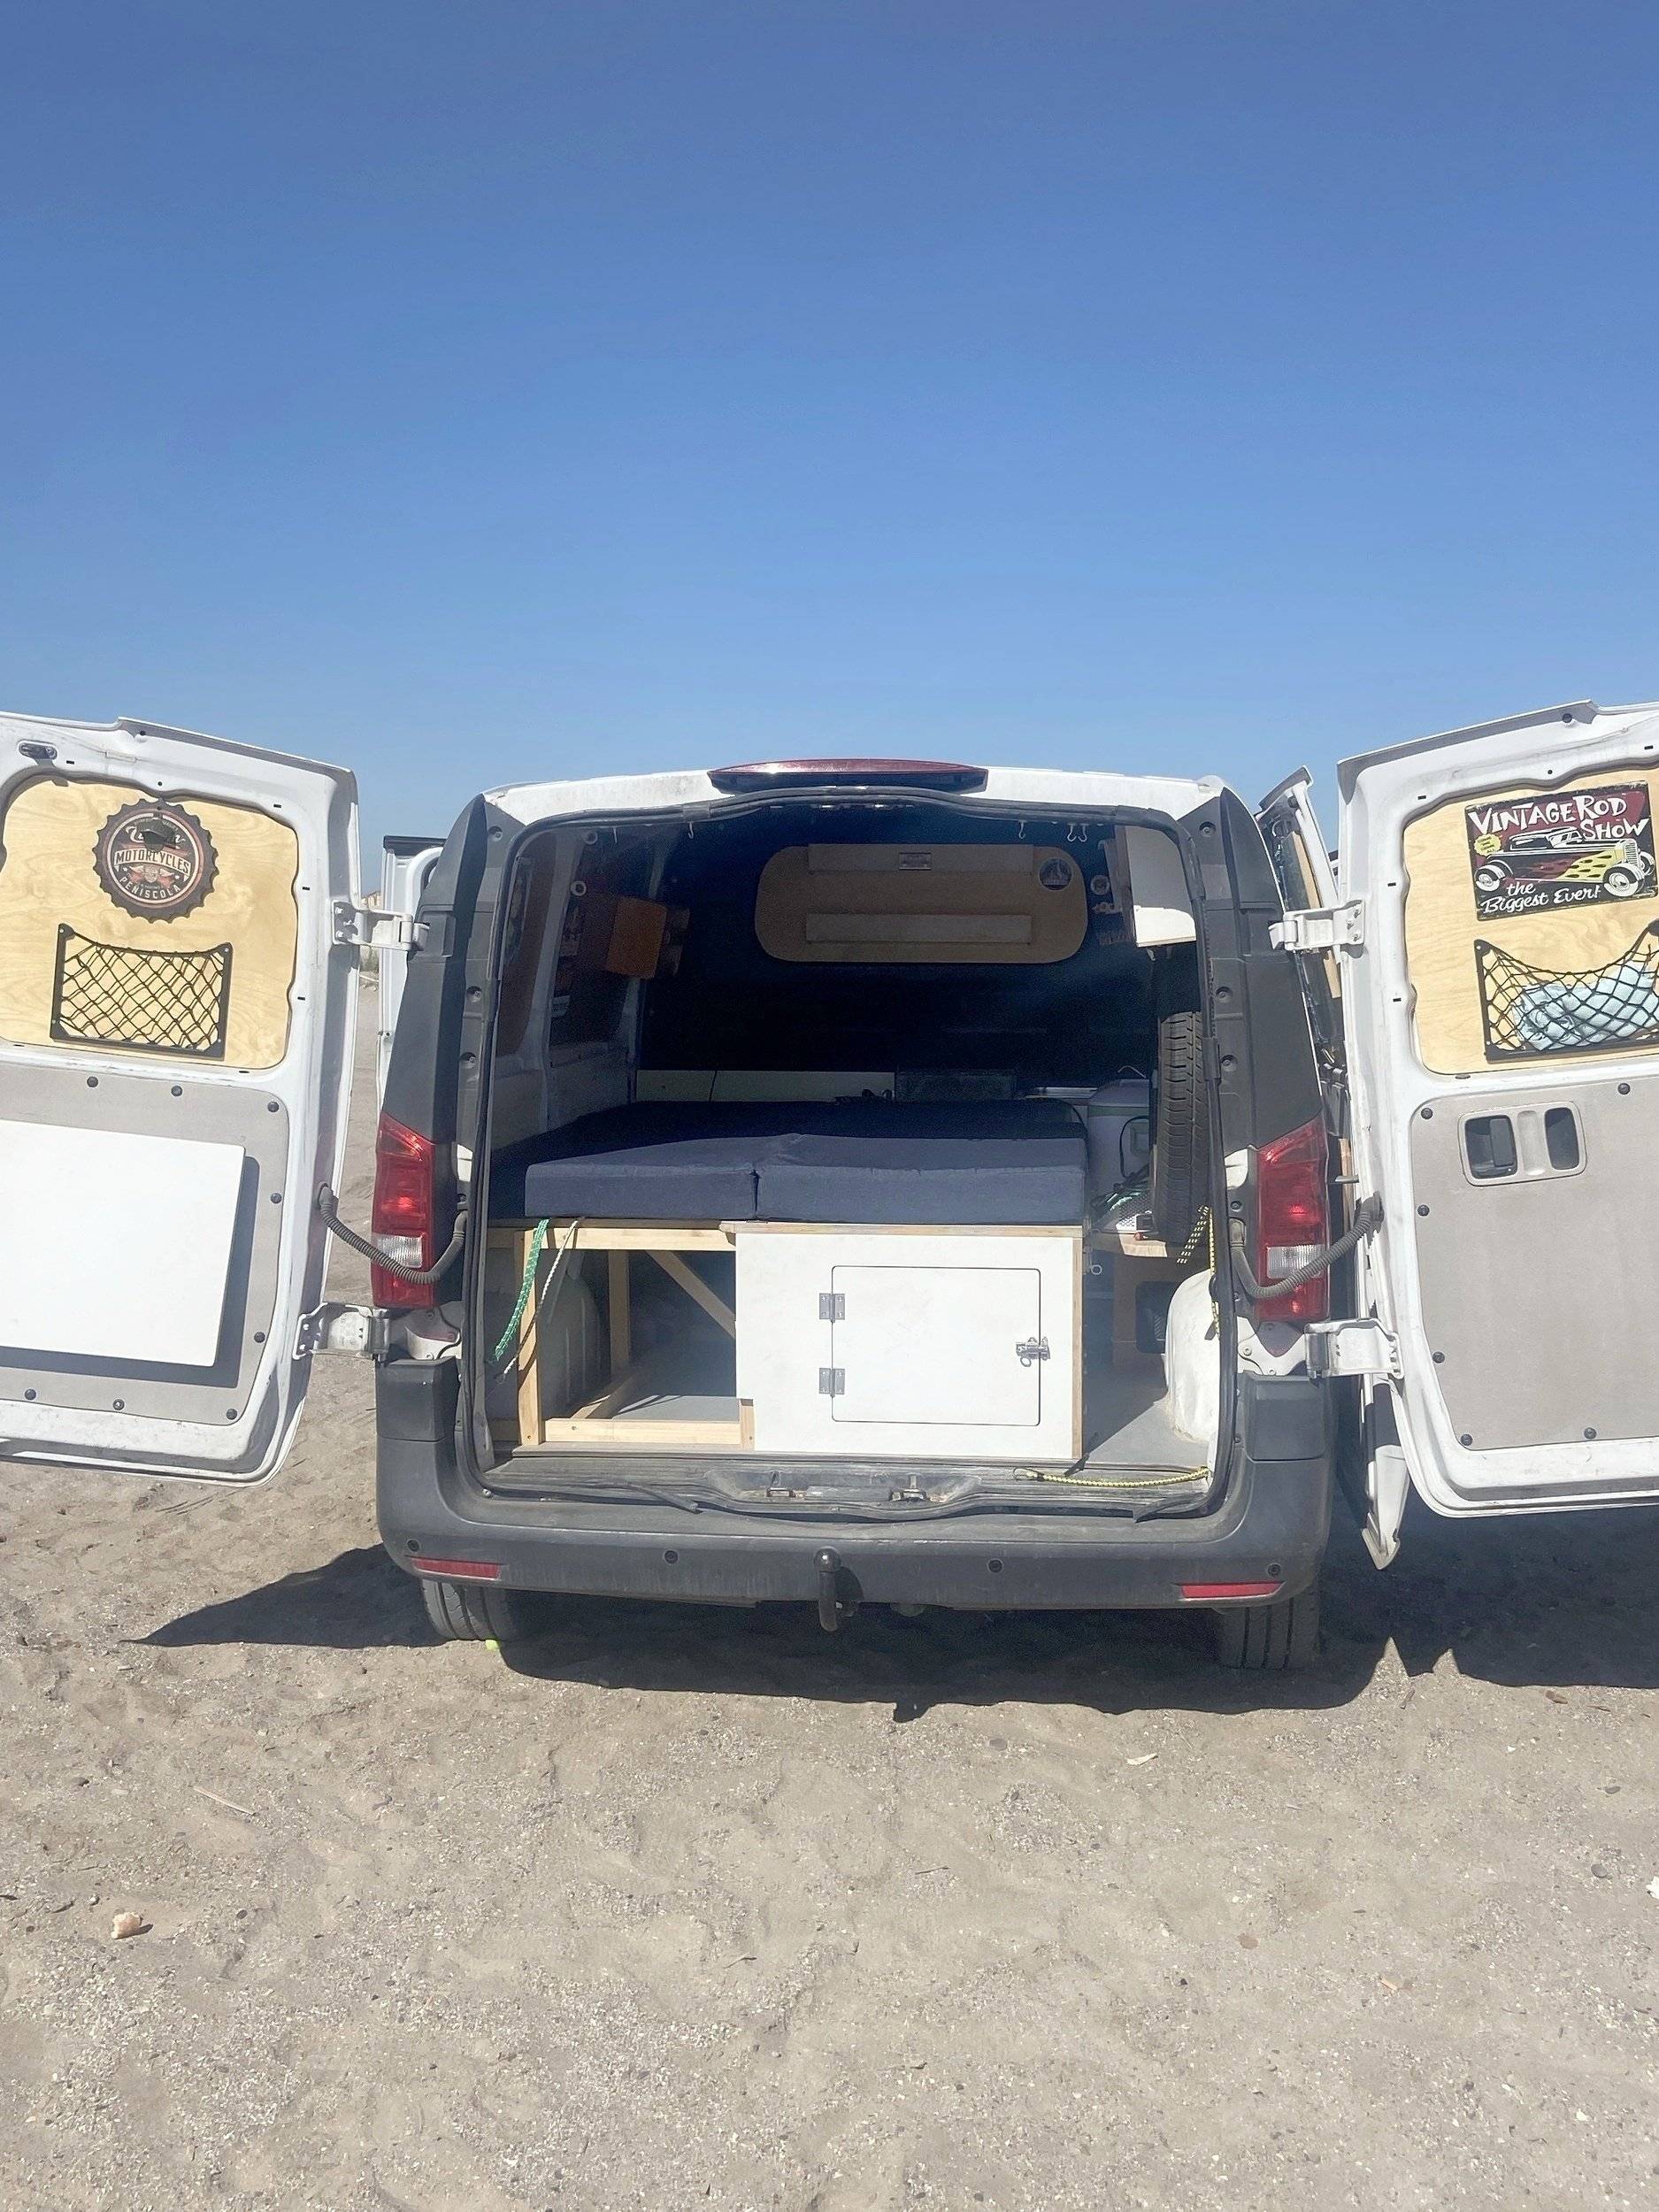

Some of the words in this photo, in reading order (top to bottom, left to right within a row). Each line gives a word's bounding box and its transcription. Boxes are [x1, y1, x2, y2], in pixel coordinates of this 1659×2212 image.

[1468, 803, 1575, 834] VINTAGE
[1572, 795, 1627, 821] ROD
[1579, 818, 1650, 841] SHOW
[116, 849, 189, 874] MOTORCYCLES
[119, 876, 181, 900] PENISCOLA
[1480, 891, 1549, 914] Biggest
[1553, 885, 1601, 903] Ever!
[1505, 881, 1537, 897] the
